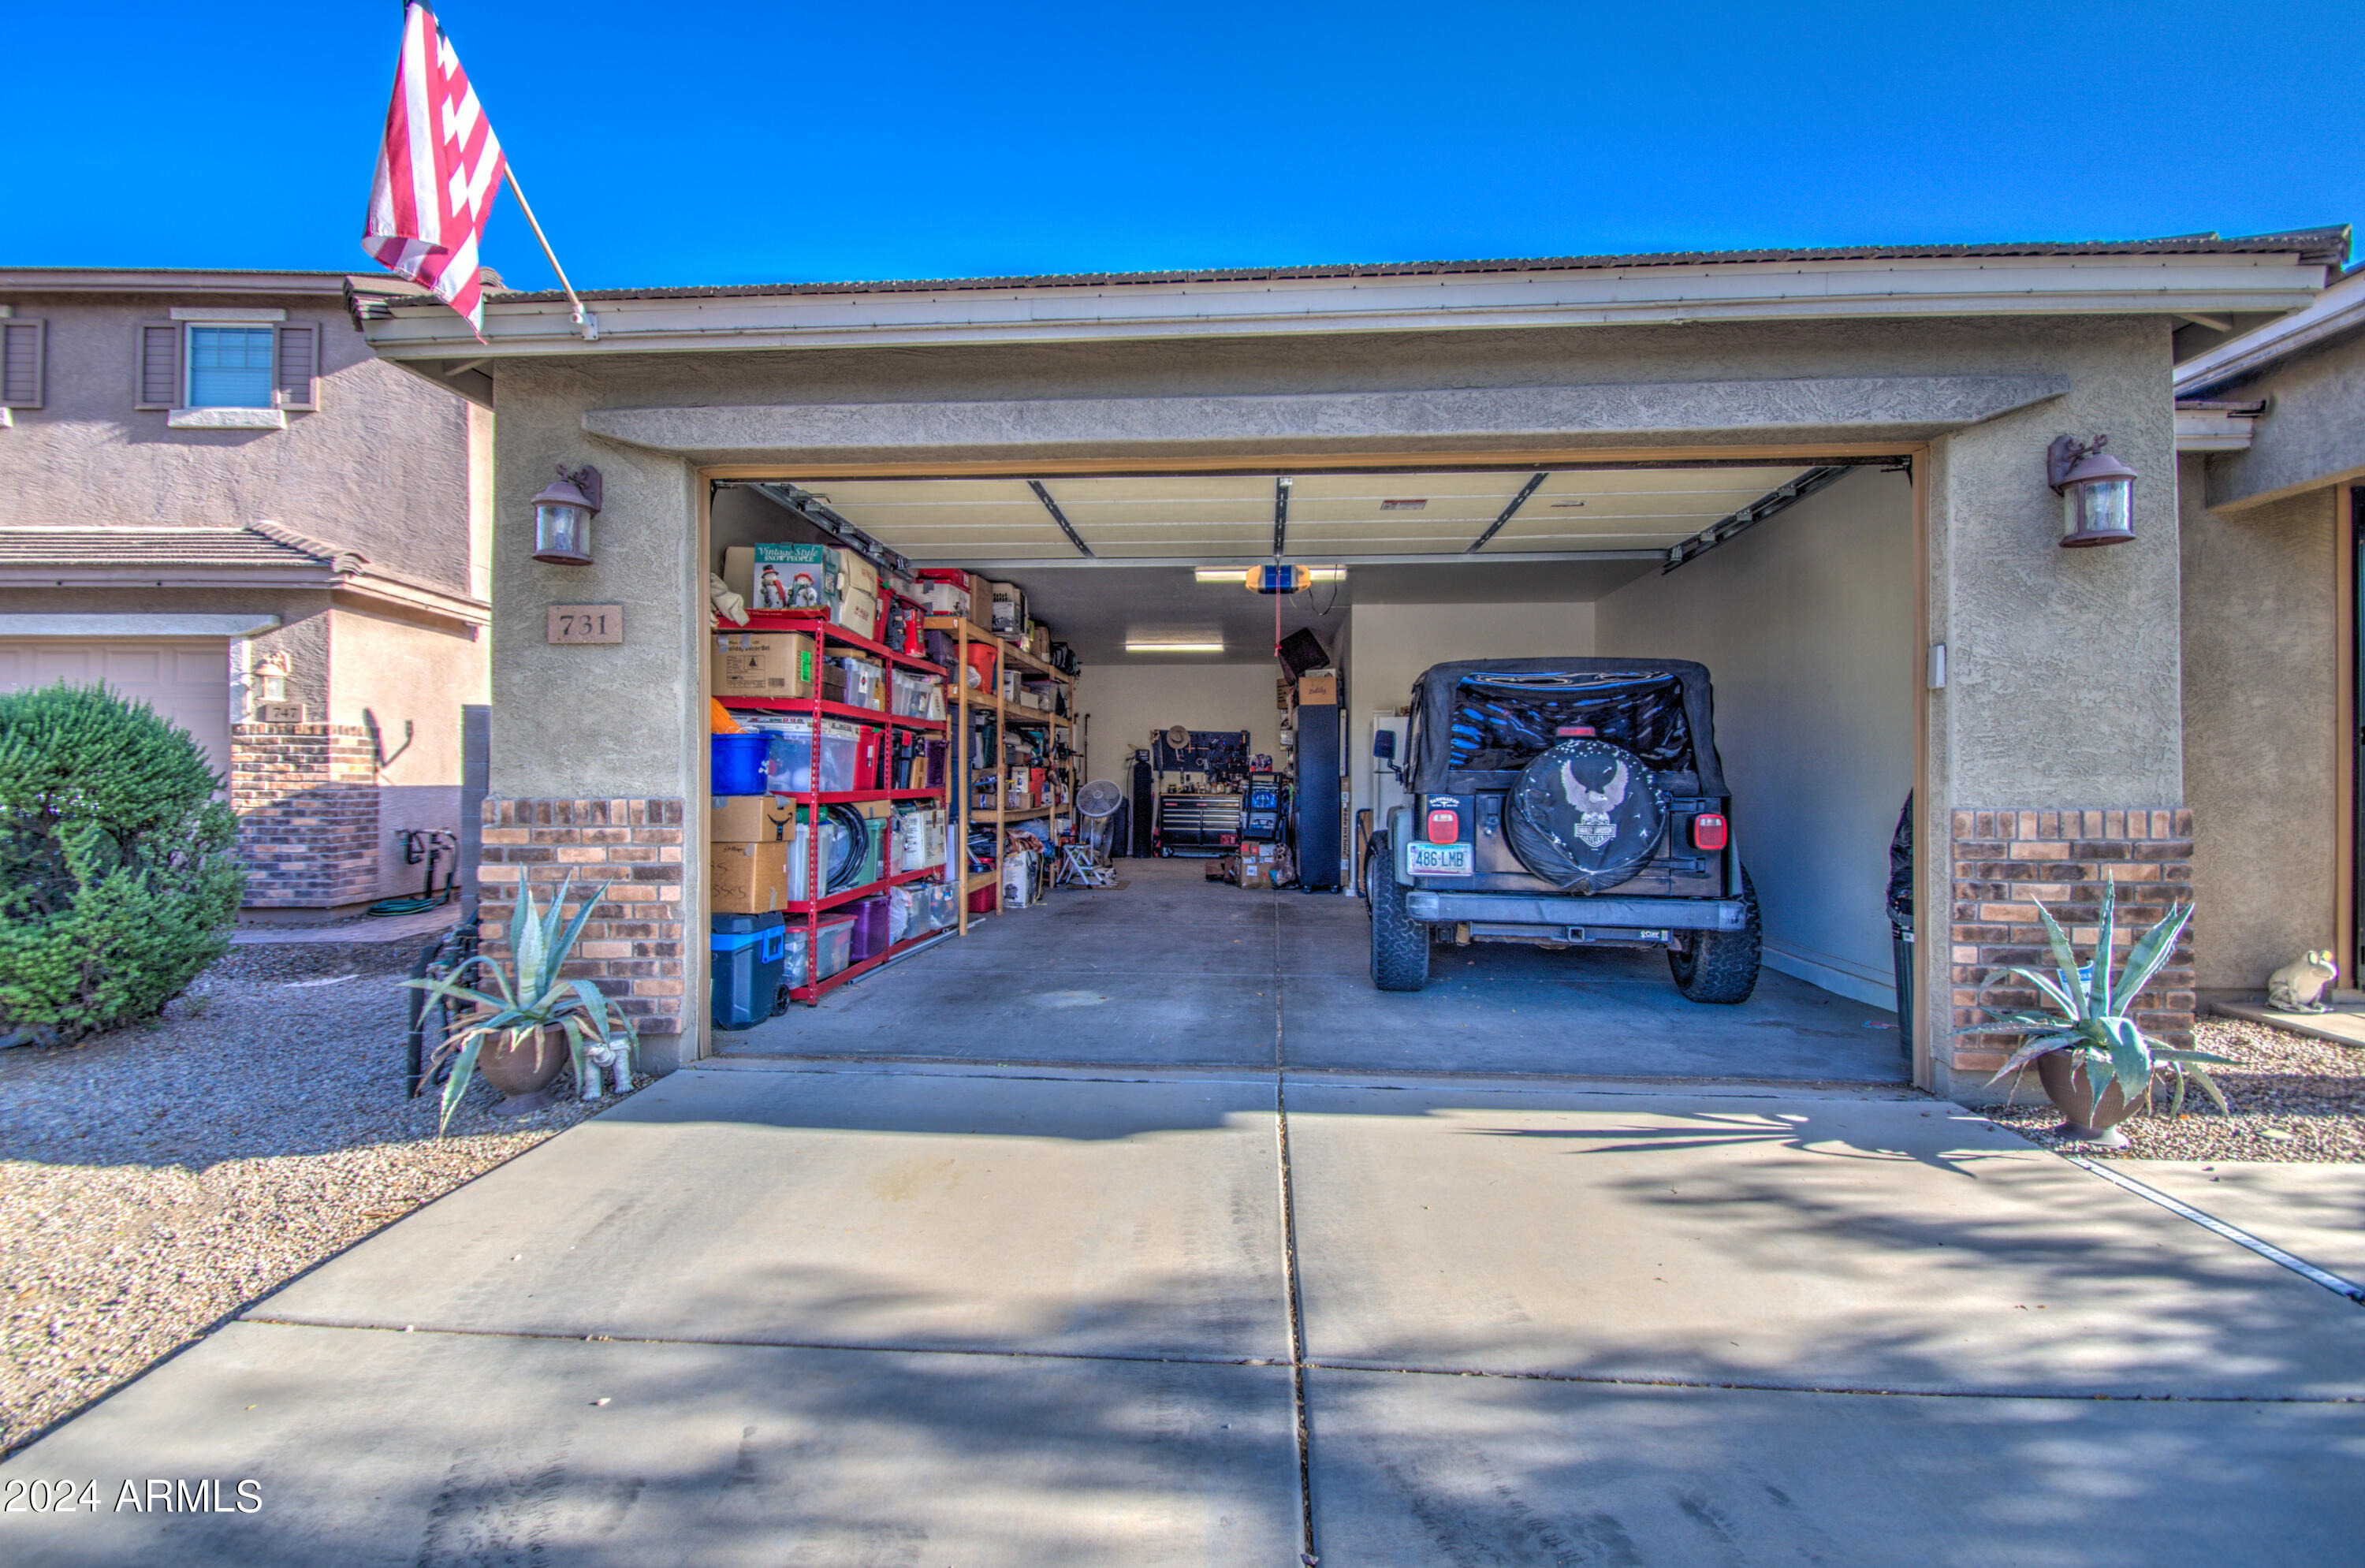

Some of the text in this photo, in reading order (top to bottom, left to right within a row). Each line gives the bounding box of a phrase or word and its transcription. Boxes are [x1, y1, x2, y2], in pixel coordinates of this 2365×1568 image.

[758, 546, 818, 557] Vintage Style
[560, 615, 607, 635] 731
[273, 707, 296, 717] 747
